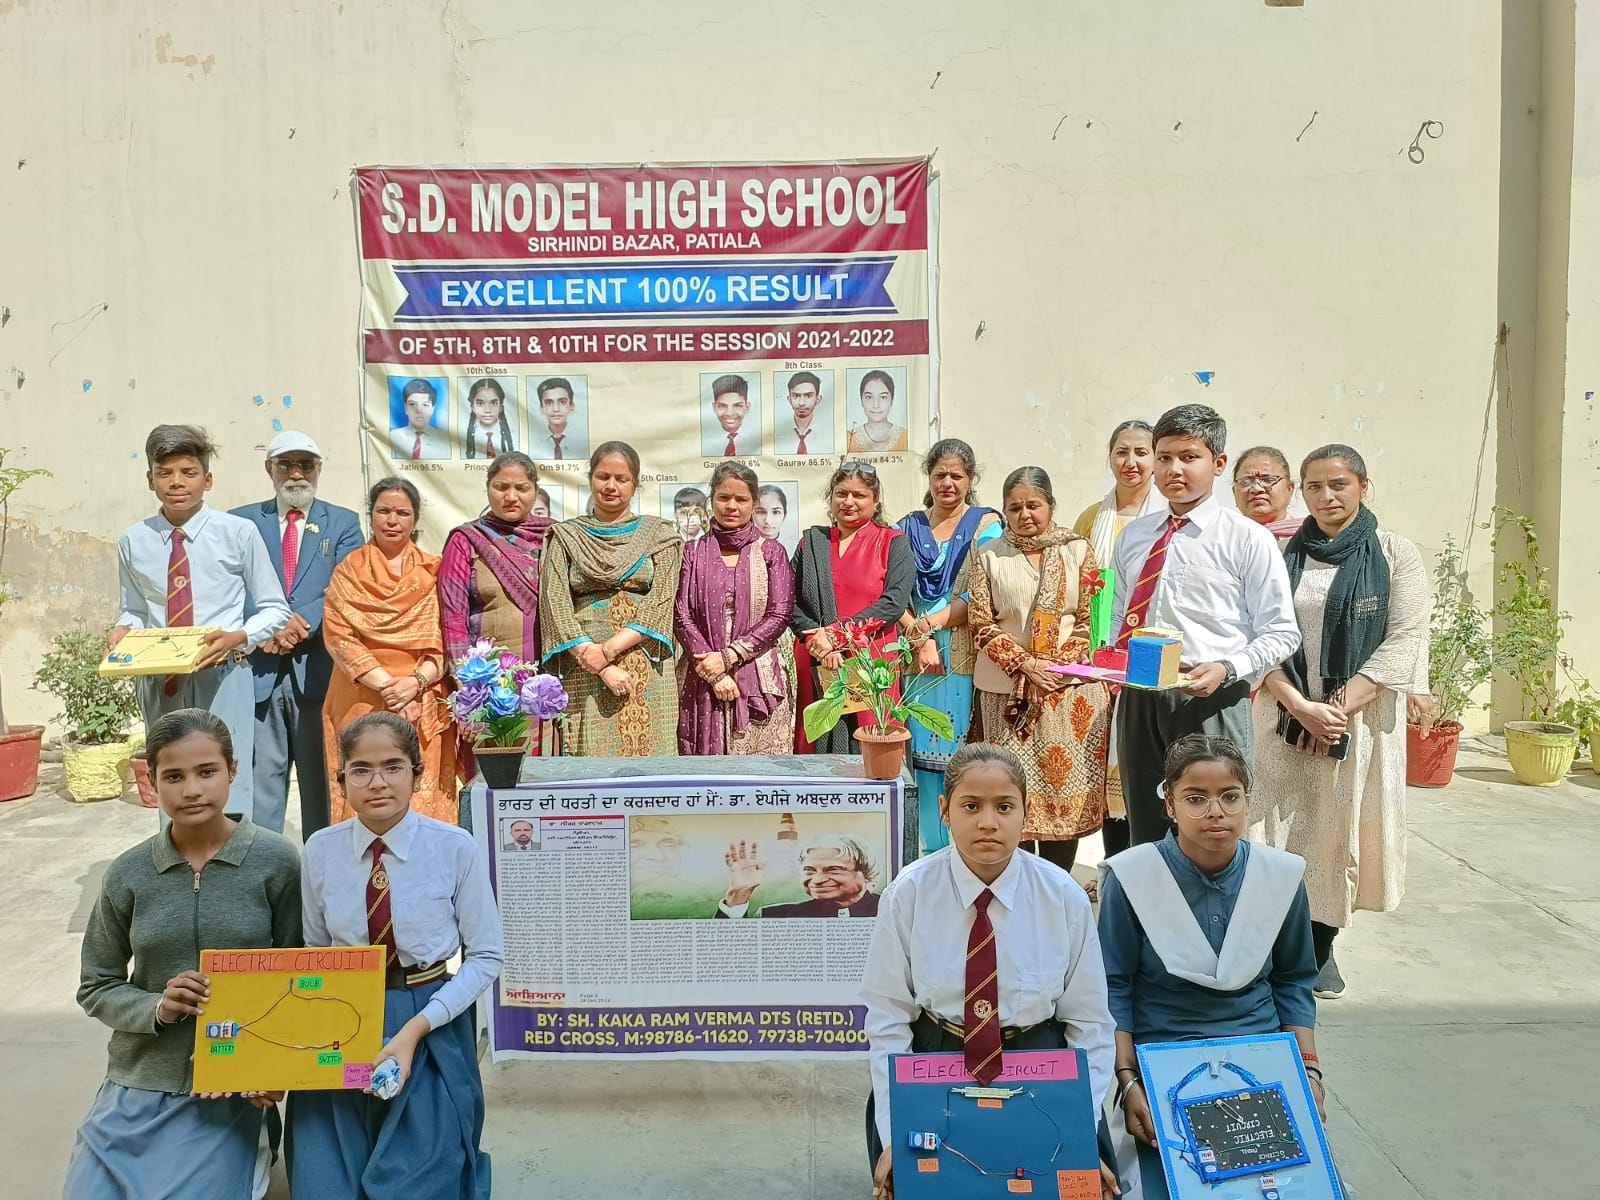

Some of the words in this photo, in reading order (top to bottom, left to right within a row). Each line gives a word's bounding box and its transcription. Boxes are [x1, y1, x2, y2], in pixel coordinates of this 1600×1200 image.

[381, 182, 457, 234] S.D.
[471, 181, 612, 233] MODEL
[625, 179, 727, 231] HIGH
[740, 175, 906, 229] SCHOOL
[527, 235, 607, 253] SIRHINDI
[612, 234, 680, 253] BAZAR,
[686, 232, 762, 250] PATIALA
[441, 277, 628, 308] EXCELLENT
[637, 275, 717, 304] 100%
[727, 273, 849, 302] RESULT
[399, 338, 427, 356] OF
[433, 337, 477, 357] 5TH,
[482, 336, 521, 355] 8TH
[527, 335, 542, 353] &
[549, 335, 597, 354] 10TH
[604, 334, 648, 353] FOR
[653, 333, 694, 352] THE
[700, 331, 791, 351] SESSION
[797, 329, 894, 349] 2021-2022
[466, 366, 483, 375] 10th
[485, 366, 508, 375] Class
[785, 362, 798, 370] 8th
[799, 361, 823, 370] Class
[777, 458, 806, 467] Gaurav
[879, 455, 904, 464] 84.3%
[655, 473, 678, 482] Class
[499, 798, 534, 812] ਭਾਰਤ
[539, 793, 559, 811] ਦੀ
[602, 796, 618, 810] ਦਾ
[686, 792, 701, 808] ਹਾਂ
[755, 789, 791, 806] ਏਪੀਜੇ
[797, 792, 843, 808] ਅਬਦੁਲ
[847, 792, 886, 805] ਕਲਾਮ
[212, 952, 285, 973] ELECTRIC
[294, 950, 371, 971] CIRCUIT
[536, 1013, 563, 1027] BY:
[567, 1013, 594, 1027] SH.
[599, 1012, 646, 1027] KAKA
[651, 1012, 690, 1027] RAM
[694, 1011, 755, 1026] VERMA
[759, 1011, 792, 1025] DTS
[796, 1009, 854, 1027] (RETD.)
[524, 1030, 555, 1045] RED
[560, 1030, 619, 1047] CROSS,
[624, 1029, 753, 1046] M:98786-11620,
[1233, 1129, 1275, 1145] ELECTRIC
